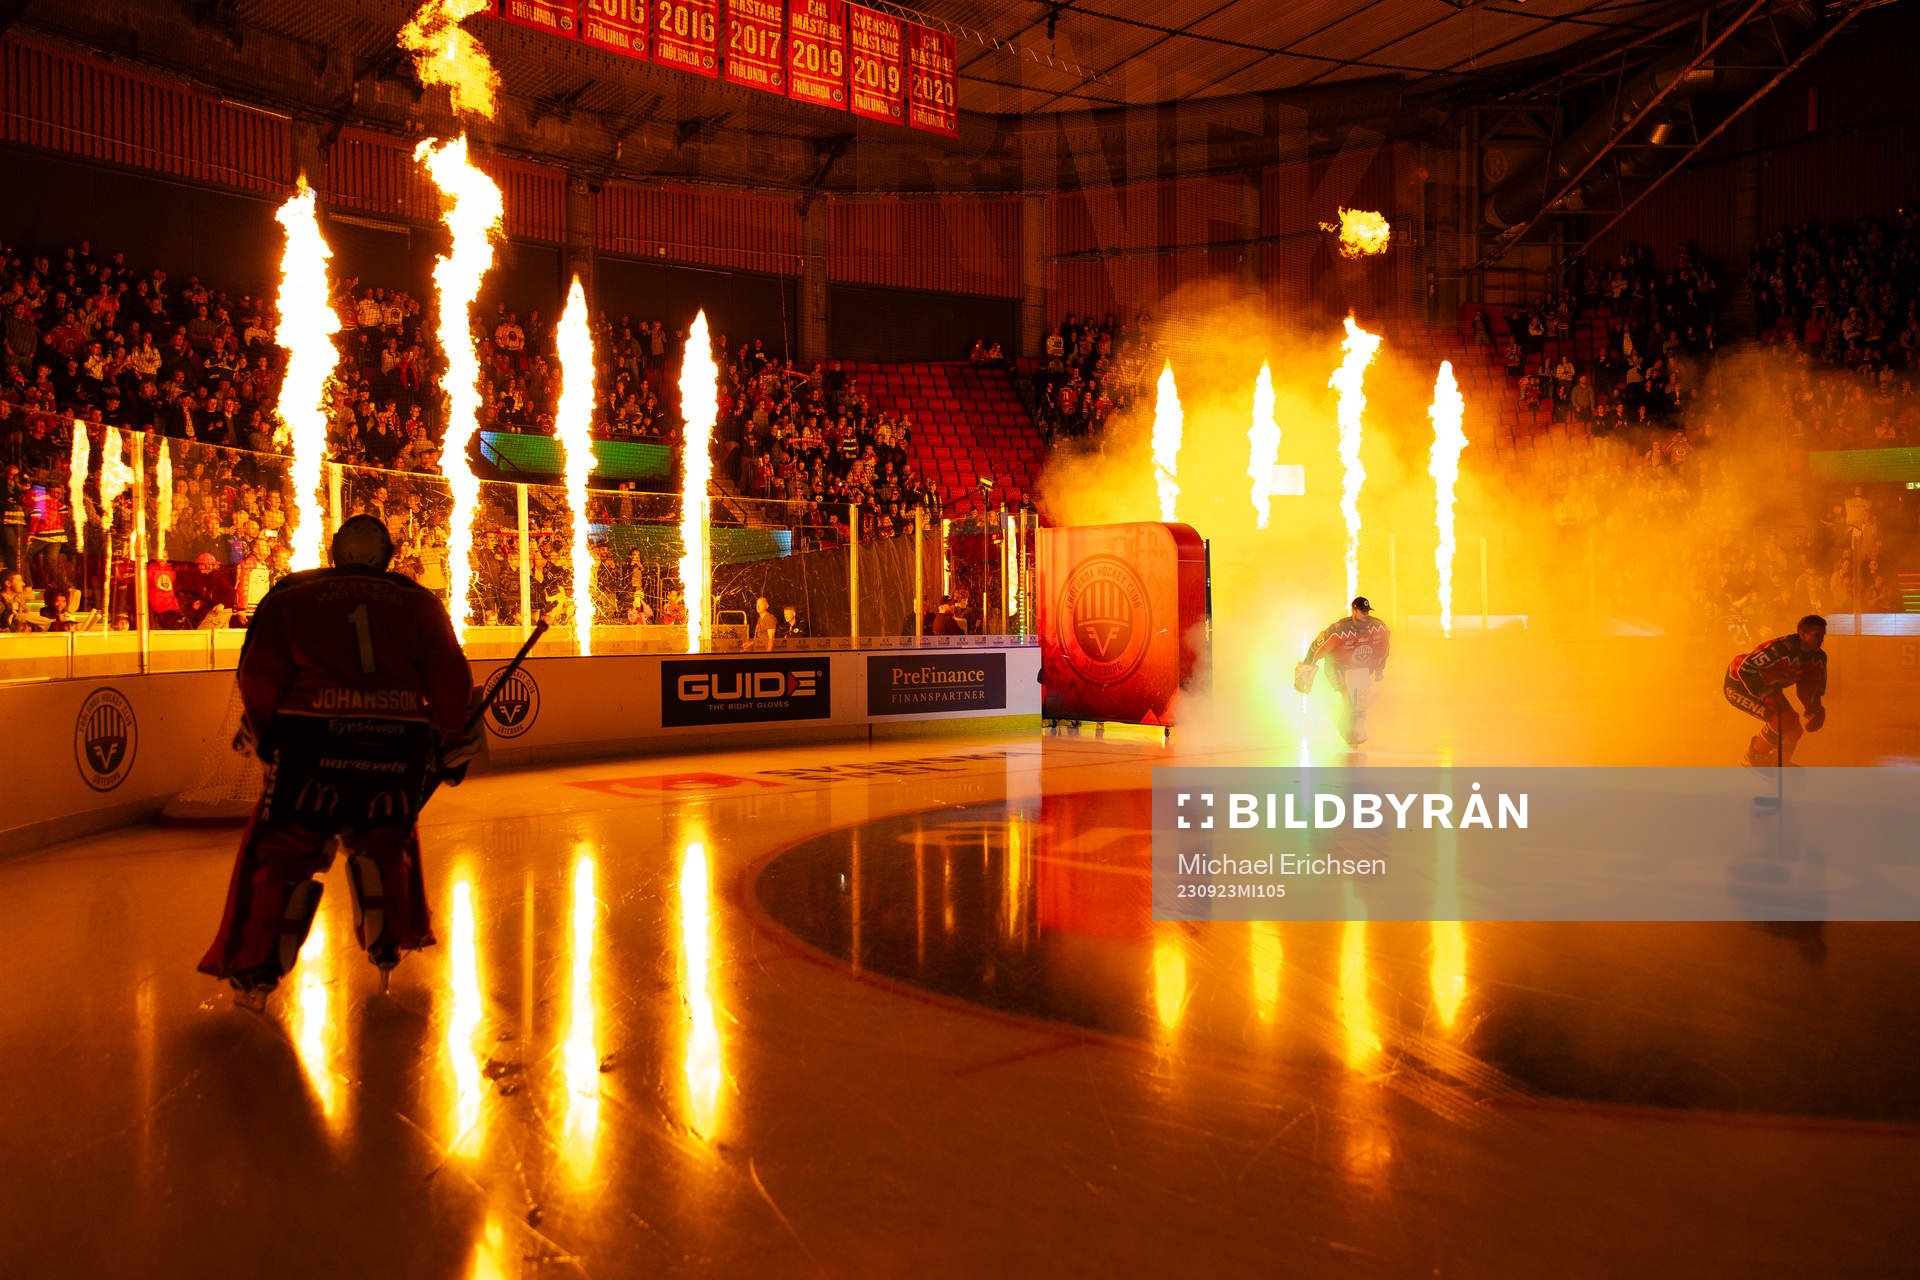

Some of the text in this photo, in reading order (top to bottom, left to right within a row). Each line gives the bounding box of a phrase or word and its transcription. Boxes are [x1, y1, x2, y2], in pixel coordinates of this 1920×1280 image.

[512, 2, 557, 28] FRÖLUNDA
[659, 1, 715, 42] 2016
[807, 0, 828, 19] CHL
[587, 23, 630, 48] FRÖLUNDA
[792, 12, 842, 40] MÄSTARE
[853, 12, 899, 40] SVENSKA
[730, 20, 781, 59] 2017
[852, 30, 900, 57] MÄSTARE
[923, 35, 942, 52] CHL
[658, 43, 700, 66] FRÖLUNDA
[792, 39, 843, 77] 2019
[911, 49, 954, 72] MÄSTARE
[729, 61, 768, 83] FRÖLUNDA
[854, 55, 900, 93] 2019
[792, 78, 830, 100] FRÖLUNDA
[912, 73, 954, 107] 2020
[854, 93, 890, 116] FRÖLUNDA
[913, 108, 945, 129] FRÖLUNDA
[1065, 565, 1143, 609] FRÖLUNDA HOCKEY CLUB
[348, 604, 377, 674] 1
[1084, 660, 1123, 674] GÖTEBORG
[1750, 651, 1771, 666] 15
[677, 670, 816, 701] GUIDE
[891, 666, 985, 686] PreFinance
[312, 687, 418, 712] JOHANSSON
[708, 701, 789, 711] THE RIGHT GLOVES
[891, 690, 985, 704] FINANSPARTNER
